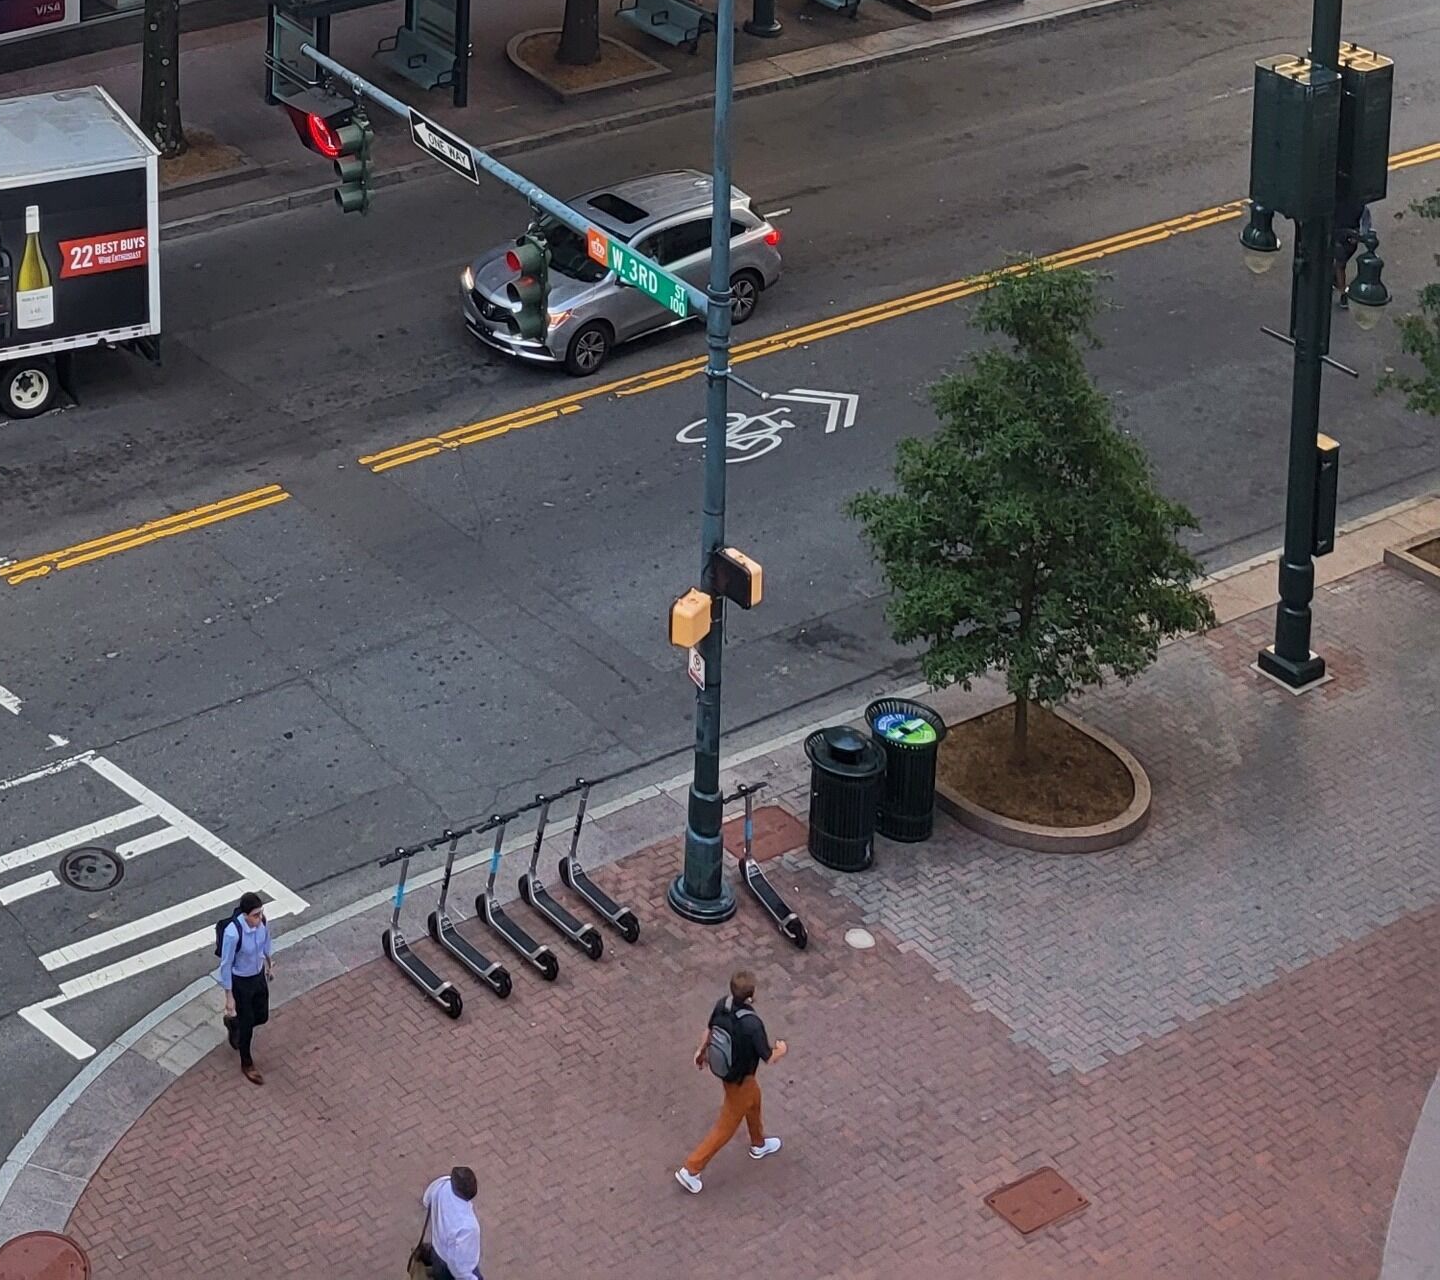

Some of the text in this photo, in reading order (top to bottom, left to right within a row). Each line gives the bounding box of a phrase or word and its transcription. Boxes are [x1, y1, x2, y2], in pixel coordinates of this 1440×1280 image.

[35, 2, 61, 16] VISA
[428, 132, 466, 166] ONE WAY
[70, 236, 146, 270] 22 BEST BUYS
[612, 246, 686, 302] W. 3RD ST
[670, 295, 685, 318] 100
